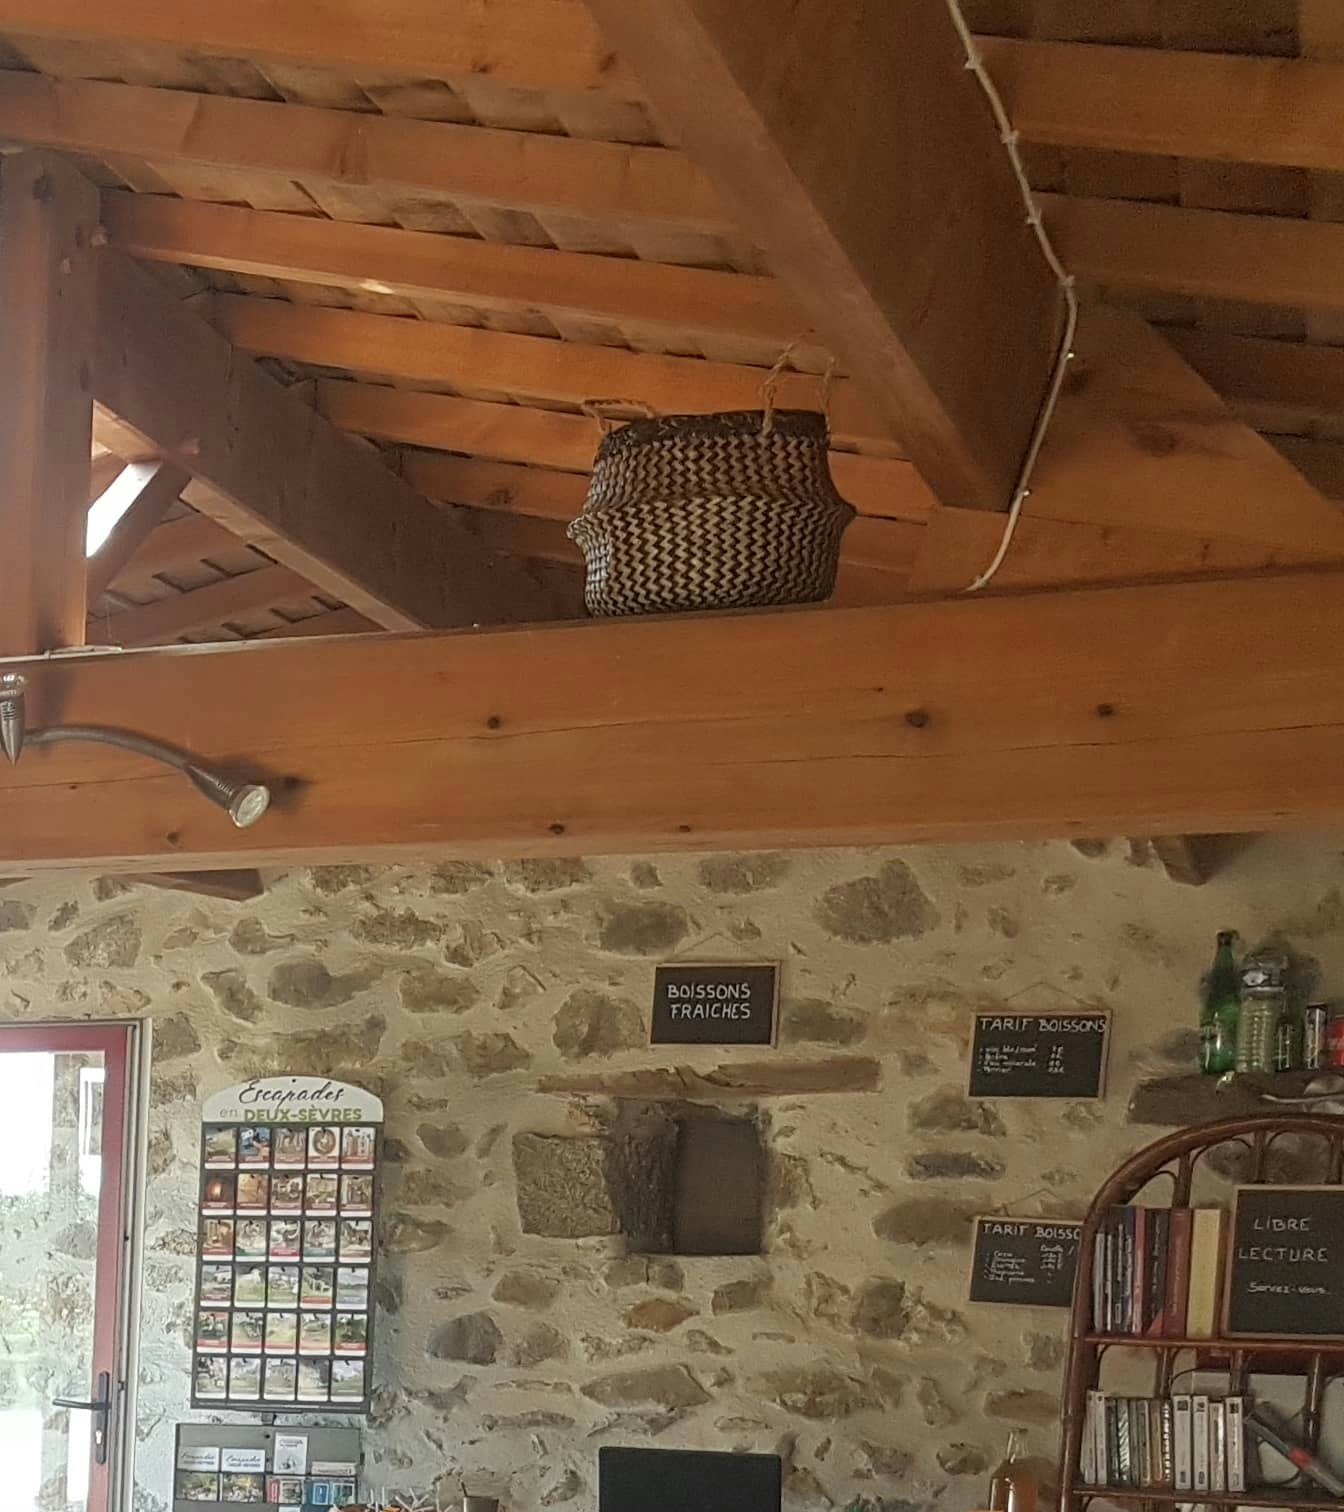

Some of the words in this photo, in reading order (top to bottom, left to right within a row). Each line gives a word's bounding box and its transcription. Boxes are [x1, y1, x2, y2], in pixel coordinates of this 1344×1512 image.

[667, 982, 751, 1000] BOISSONS
[670, 1002, 751, 1020] FRAICHES
[979, 1018, 1034, 1031] TARIF
[1038, 1018, 1106, 1033] BOISSONS
[239, 1078, 344, 1110] Escapades
[219, 1108, 238, 1119] en
[243, 1106, 362, 1122] DEUX-SÈVRES
[983, 1223, 1029, 1236] TARIF
[1253, 1216, 1311, 1231] LIBRE
[1238, 1247, 1329, 1262] LECTURE
